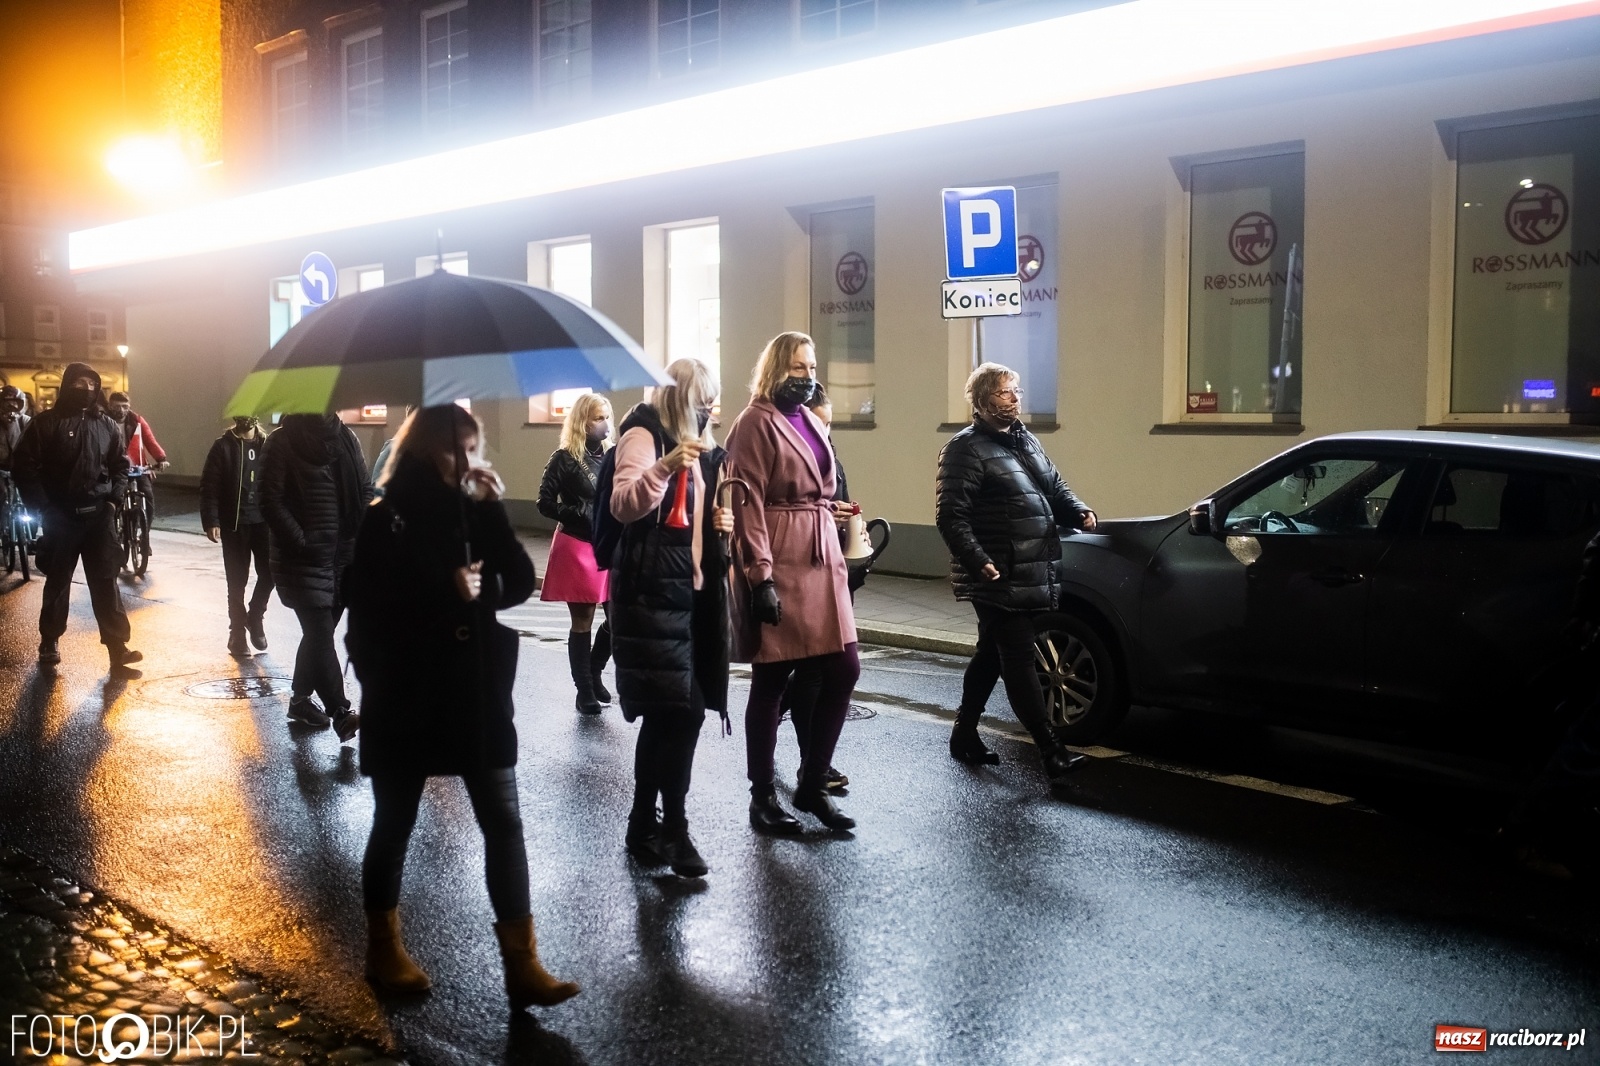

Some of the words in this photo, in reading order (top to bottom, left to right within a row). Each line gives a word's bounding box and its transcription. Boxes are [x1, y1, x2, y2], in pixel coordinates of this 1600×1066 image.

[960, 199, 1002, 268] P
[1472, 248, 1600, 274] ROSSMANN
[1504, 280, 1564, 292] Zapraszamy
[944, 288, 1020, 310] Koniec
